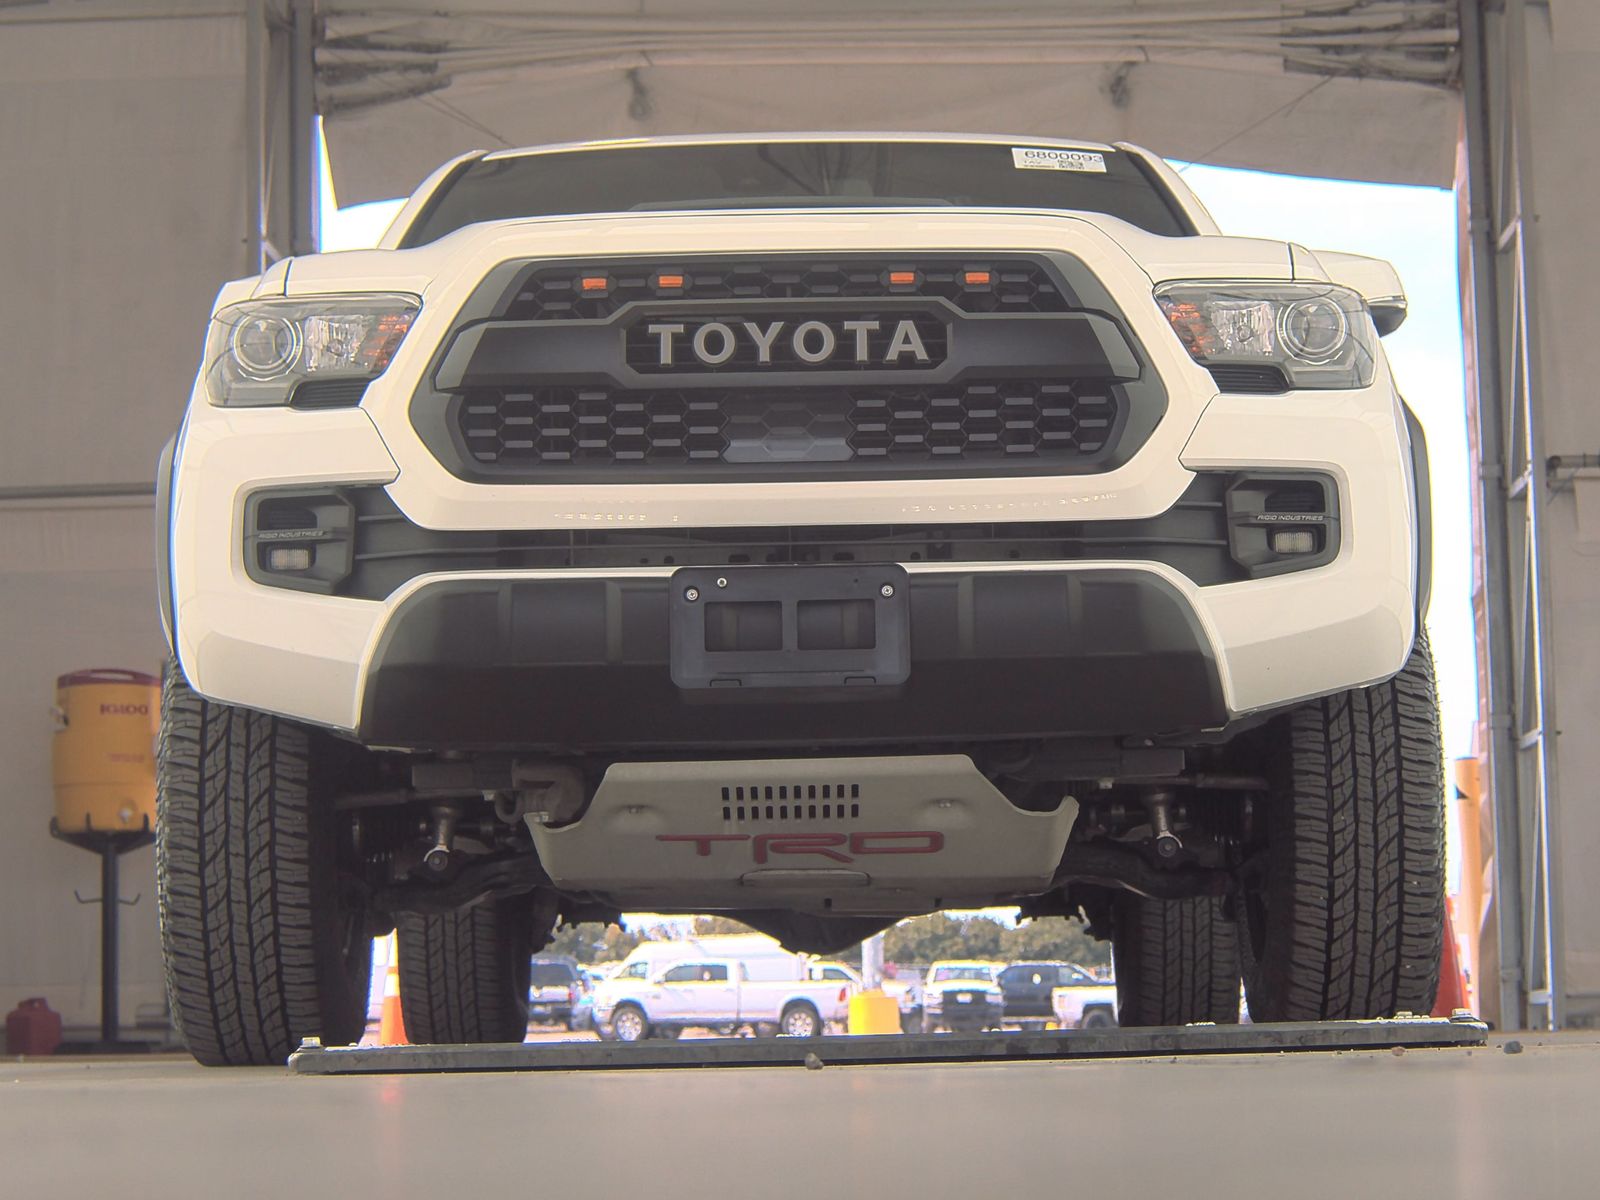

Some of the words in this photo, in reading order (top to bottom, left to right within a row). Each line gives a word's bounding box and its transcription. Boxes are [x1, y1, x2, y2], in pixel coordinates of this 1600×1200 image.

[1024, 150, 1103, 163] 6800093
[648, 320, 930, 366] TOYOTA
[279, 530, 324, 538] INDUSTRIES
[100, 703, 149, 716] IGLOO
[655, 830, 945, 864] TRD
